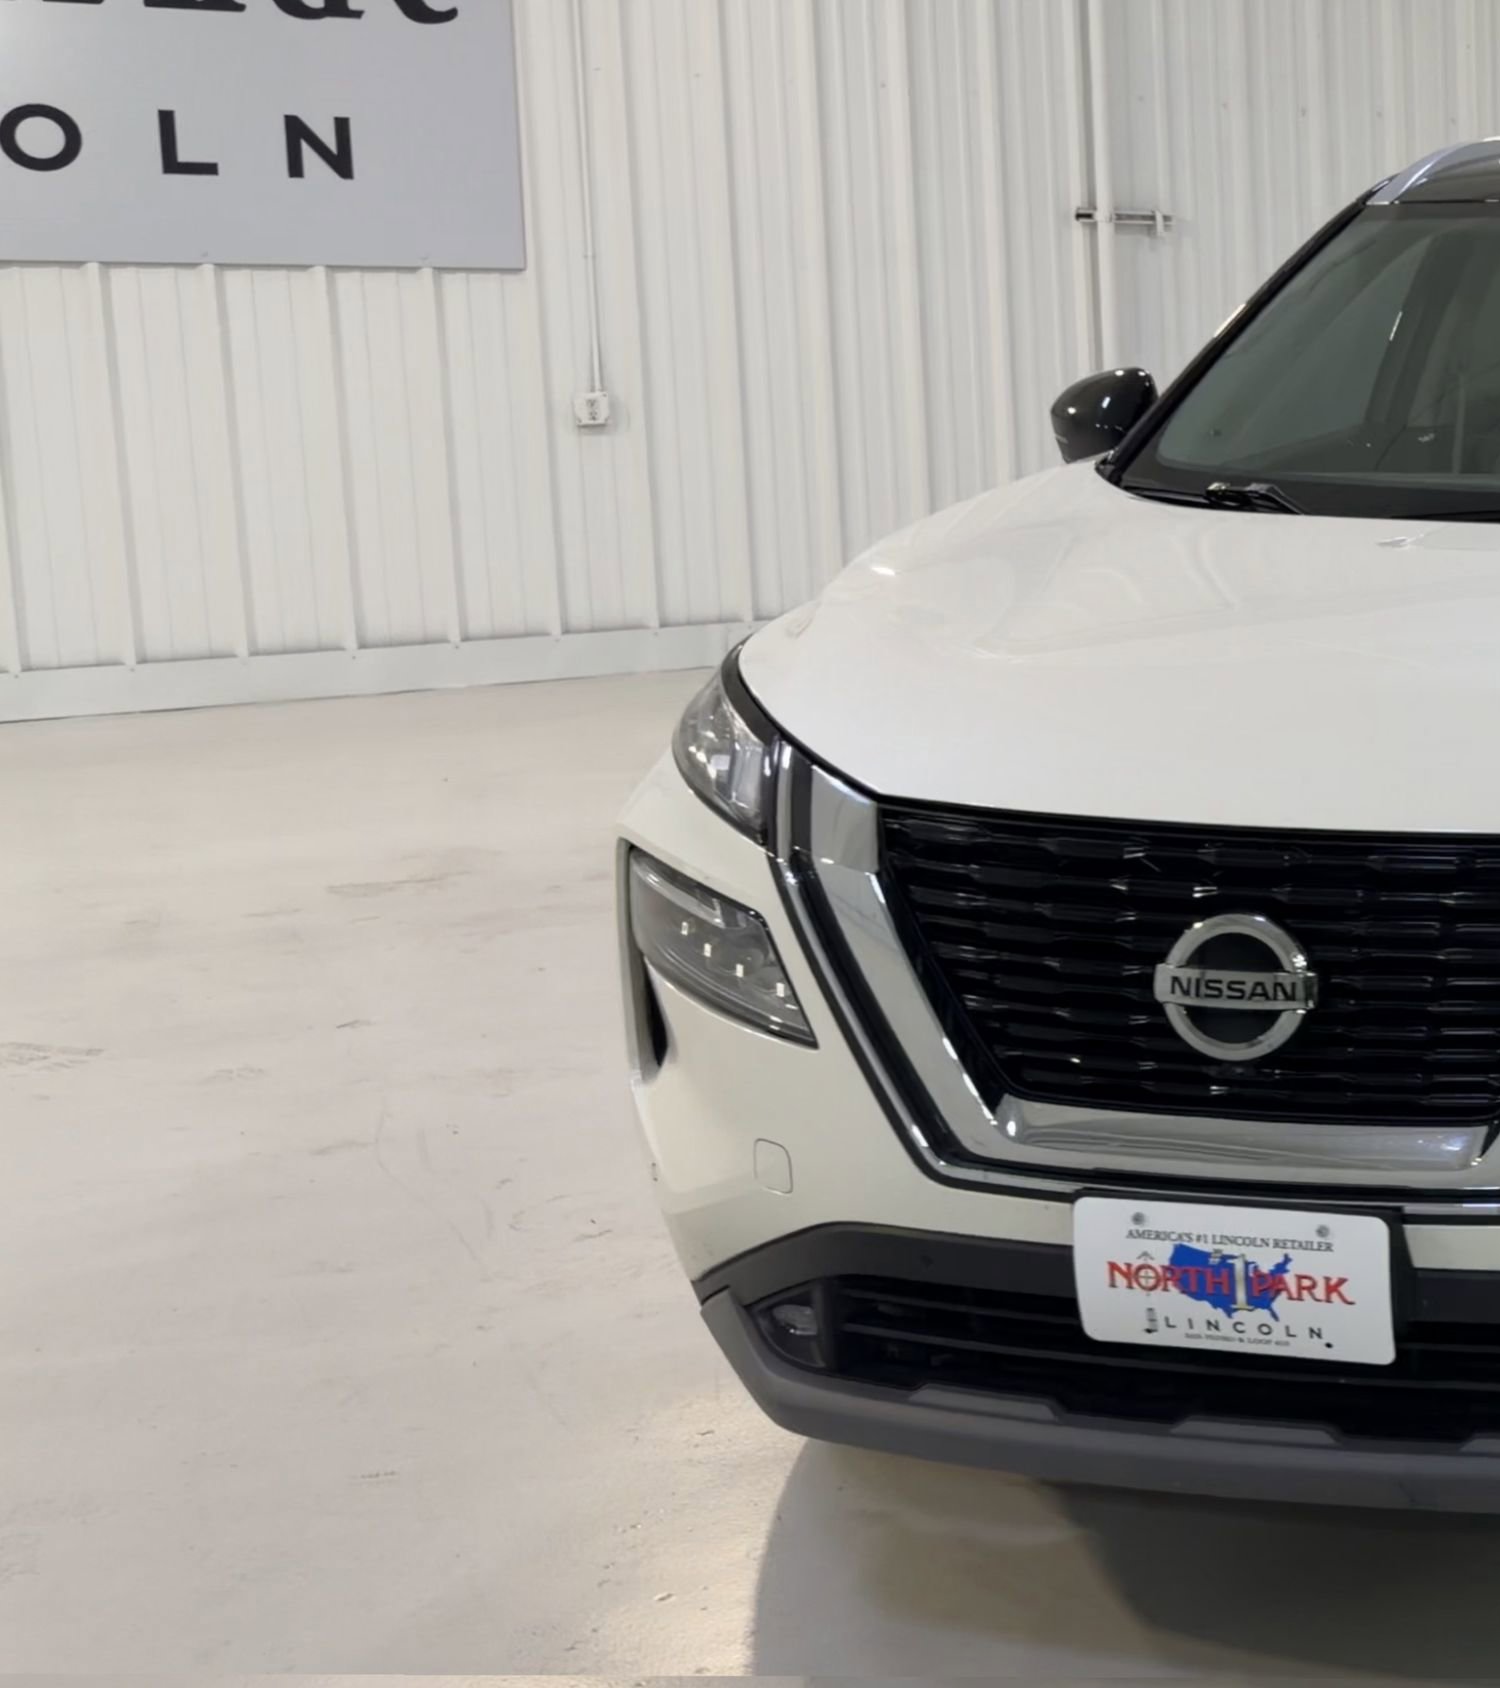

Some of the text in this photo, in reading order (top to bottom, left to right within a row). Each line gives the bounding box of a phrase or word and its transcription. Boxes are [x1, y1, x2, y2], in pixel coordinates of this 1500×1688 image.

[1170, 975, 1297, 1001] NISSAN
[1125, 1228, 1335, 1252] AMERICA'S #1 LINCOLN RETAILER
[1107, 1261, 1230, 1295] NORTH
[1252, 1271, 1356, 1305] PARK
[1164, 1315, 1323, 1339] LINCOLN
